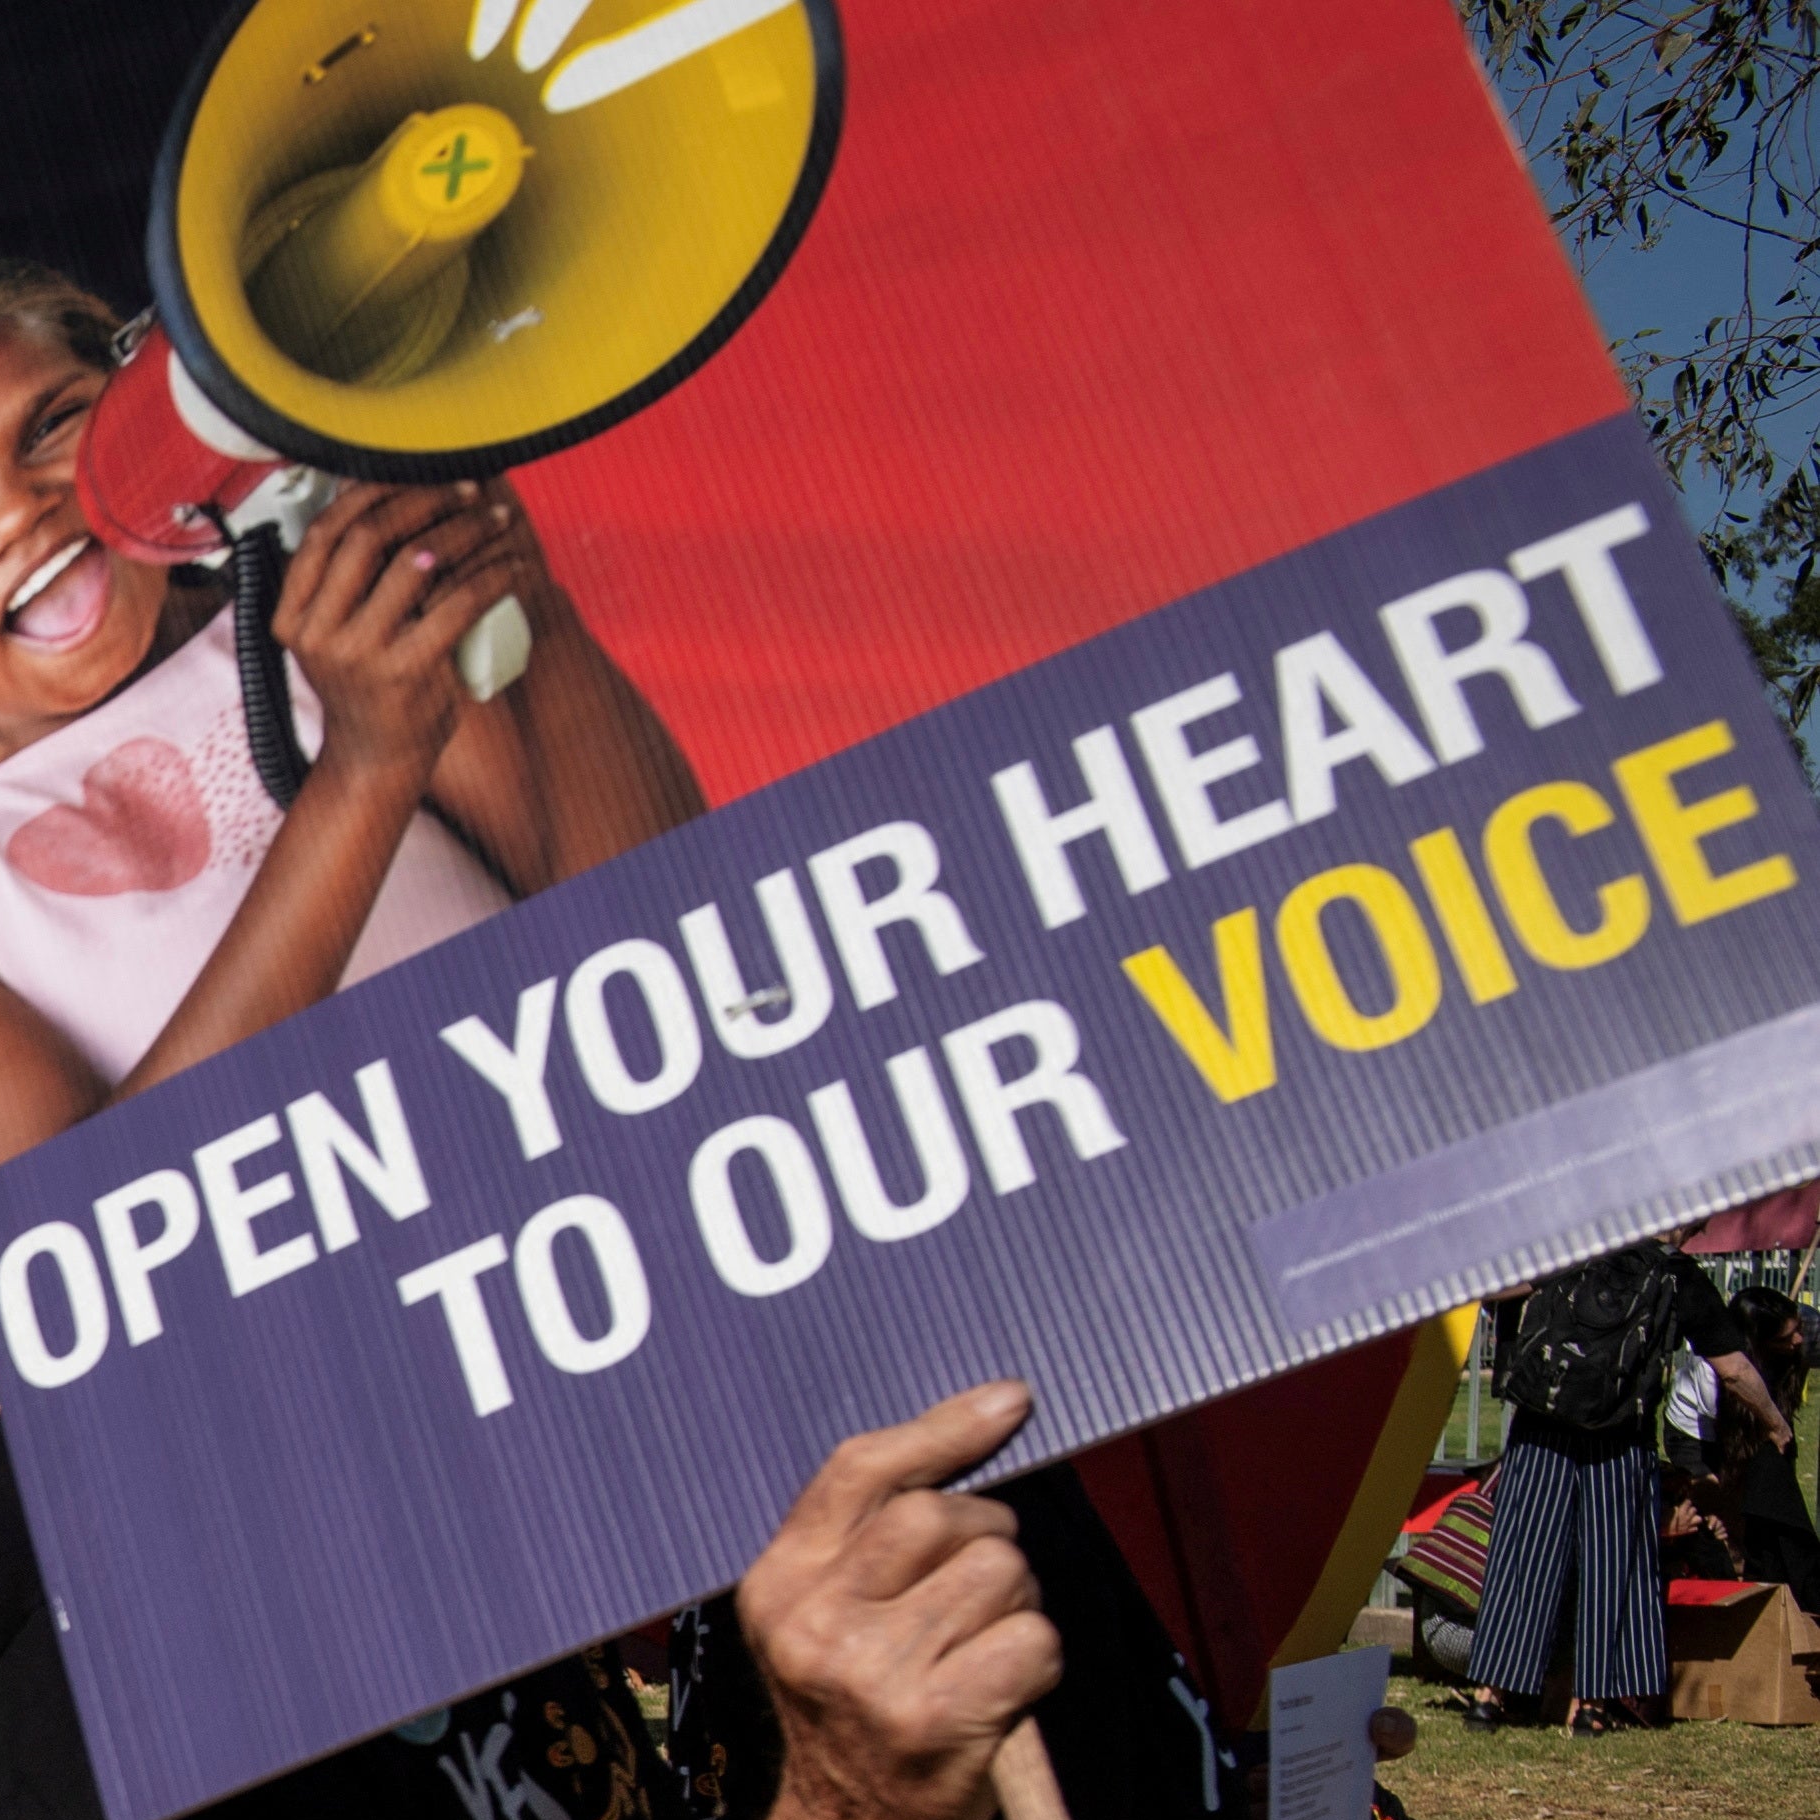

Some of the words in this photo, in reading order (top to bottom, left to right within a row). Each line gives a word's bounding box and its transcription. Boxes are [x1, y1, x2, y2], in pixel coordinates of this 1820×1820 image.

[396, 1192, 652, 1418] TO
[688, 999, 1128, 1299] OUR
[1120, 719, 1798, 1106] VOICE
[441, 820, 986, 1161] YOUR
[990, 502, 1663, 930] HEART
